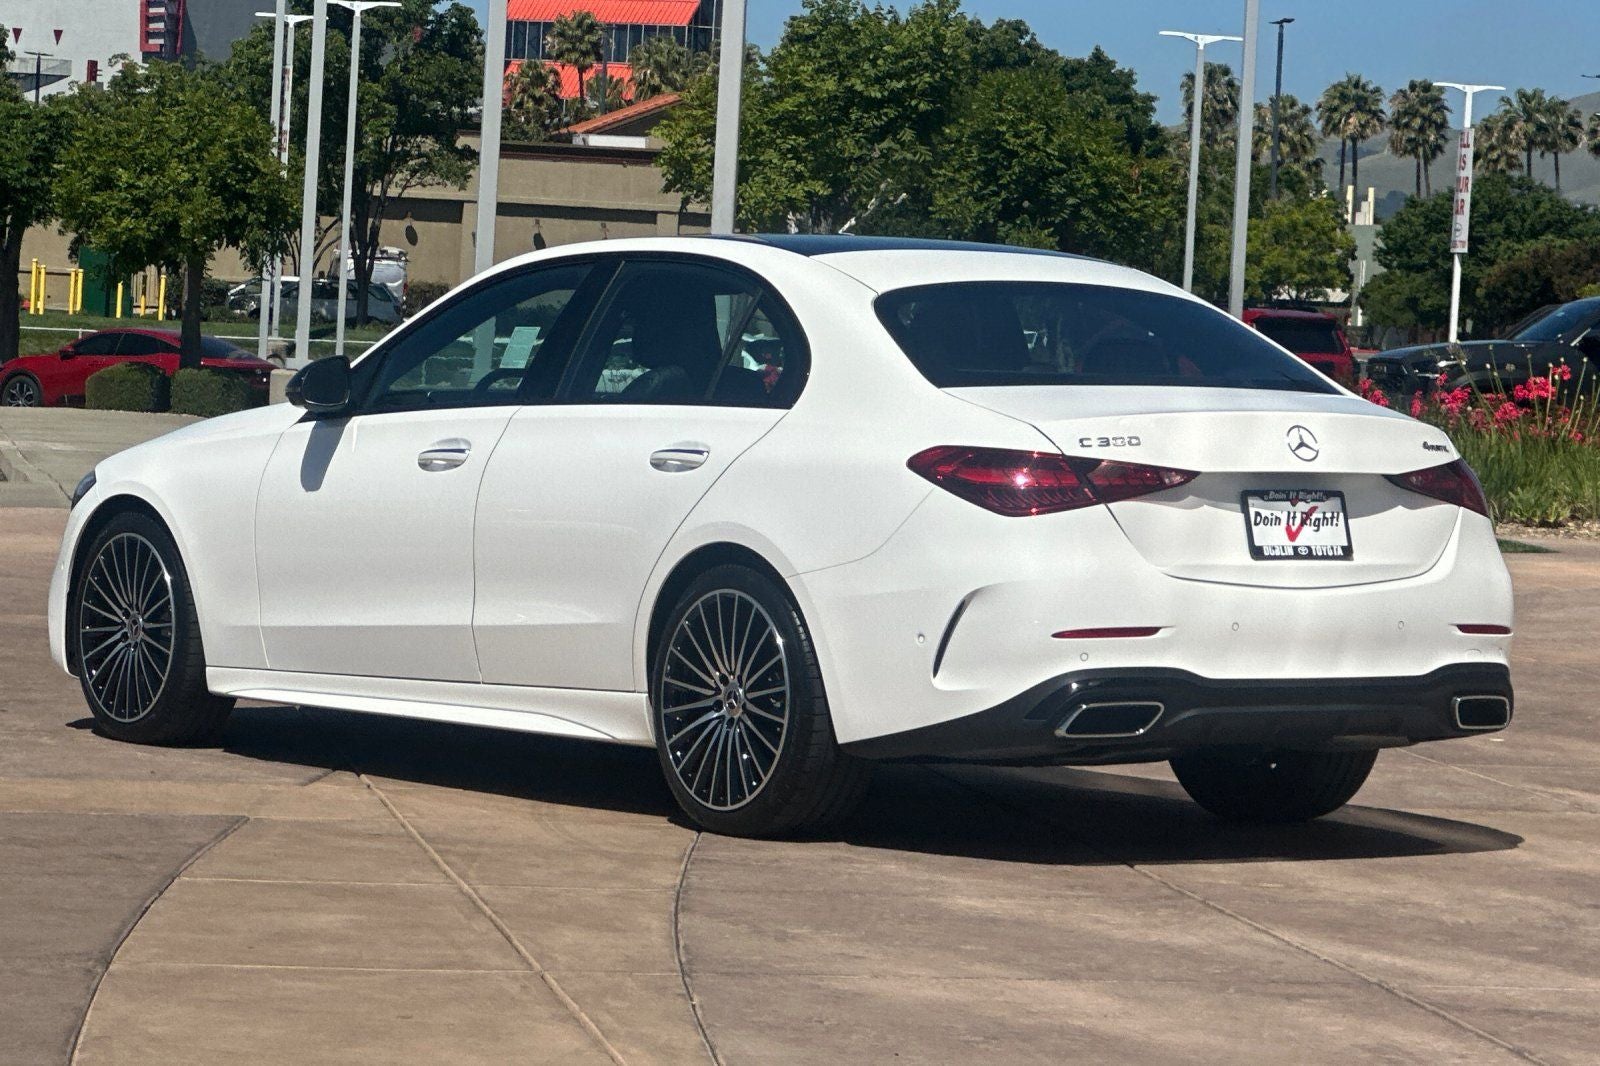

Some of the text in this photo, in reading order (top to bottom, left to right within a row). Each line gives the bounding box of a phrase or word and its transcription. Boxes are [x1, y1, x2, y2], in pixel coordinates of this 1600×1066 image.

[1079, 437, 1093, 448] C
[1253, 511, 1340, 532] Doin' It Right!
[1311, 545, 1344, 556] TOYOTA
